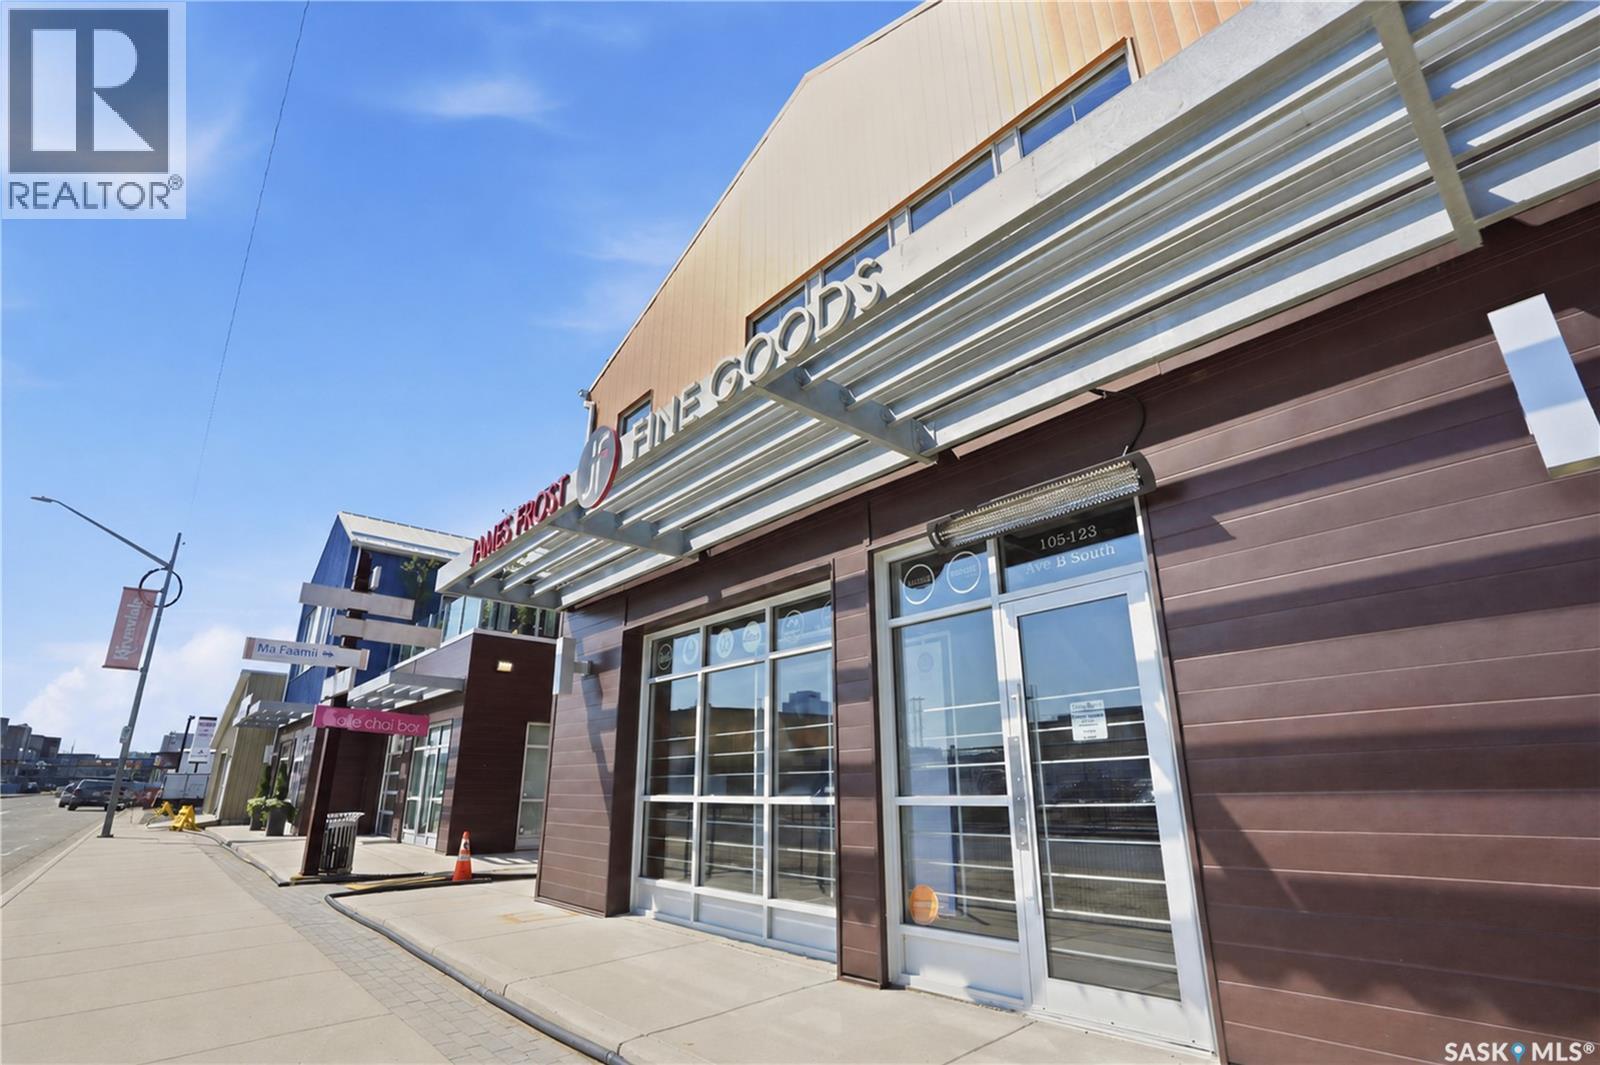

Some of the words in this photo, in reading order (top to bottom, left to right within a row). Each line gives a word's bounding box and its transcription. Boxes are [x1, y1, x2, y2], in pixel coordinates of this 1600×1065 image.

[632, 382, 702, 461] FINE
[710, 257, 884, 404] GOODS
[470, 515, 514, 567] JAMES
[515, 474, 571, 536] FROST
[1040, 524, 1098, 550] 105-123
[1025, 561, 1051, 575] Ave
[1055, 556, 1066, 568] B
[1071, 543, 1116, 564] South
[257, 643, 276, 653] Ma
[279, 645, 319, 658] Faamii
